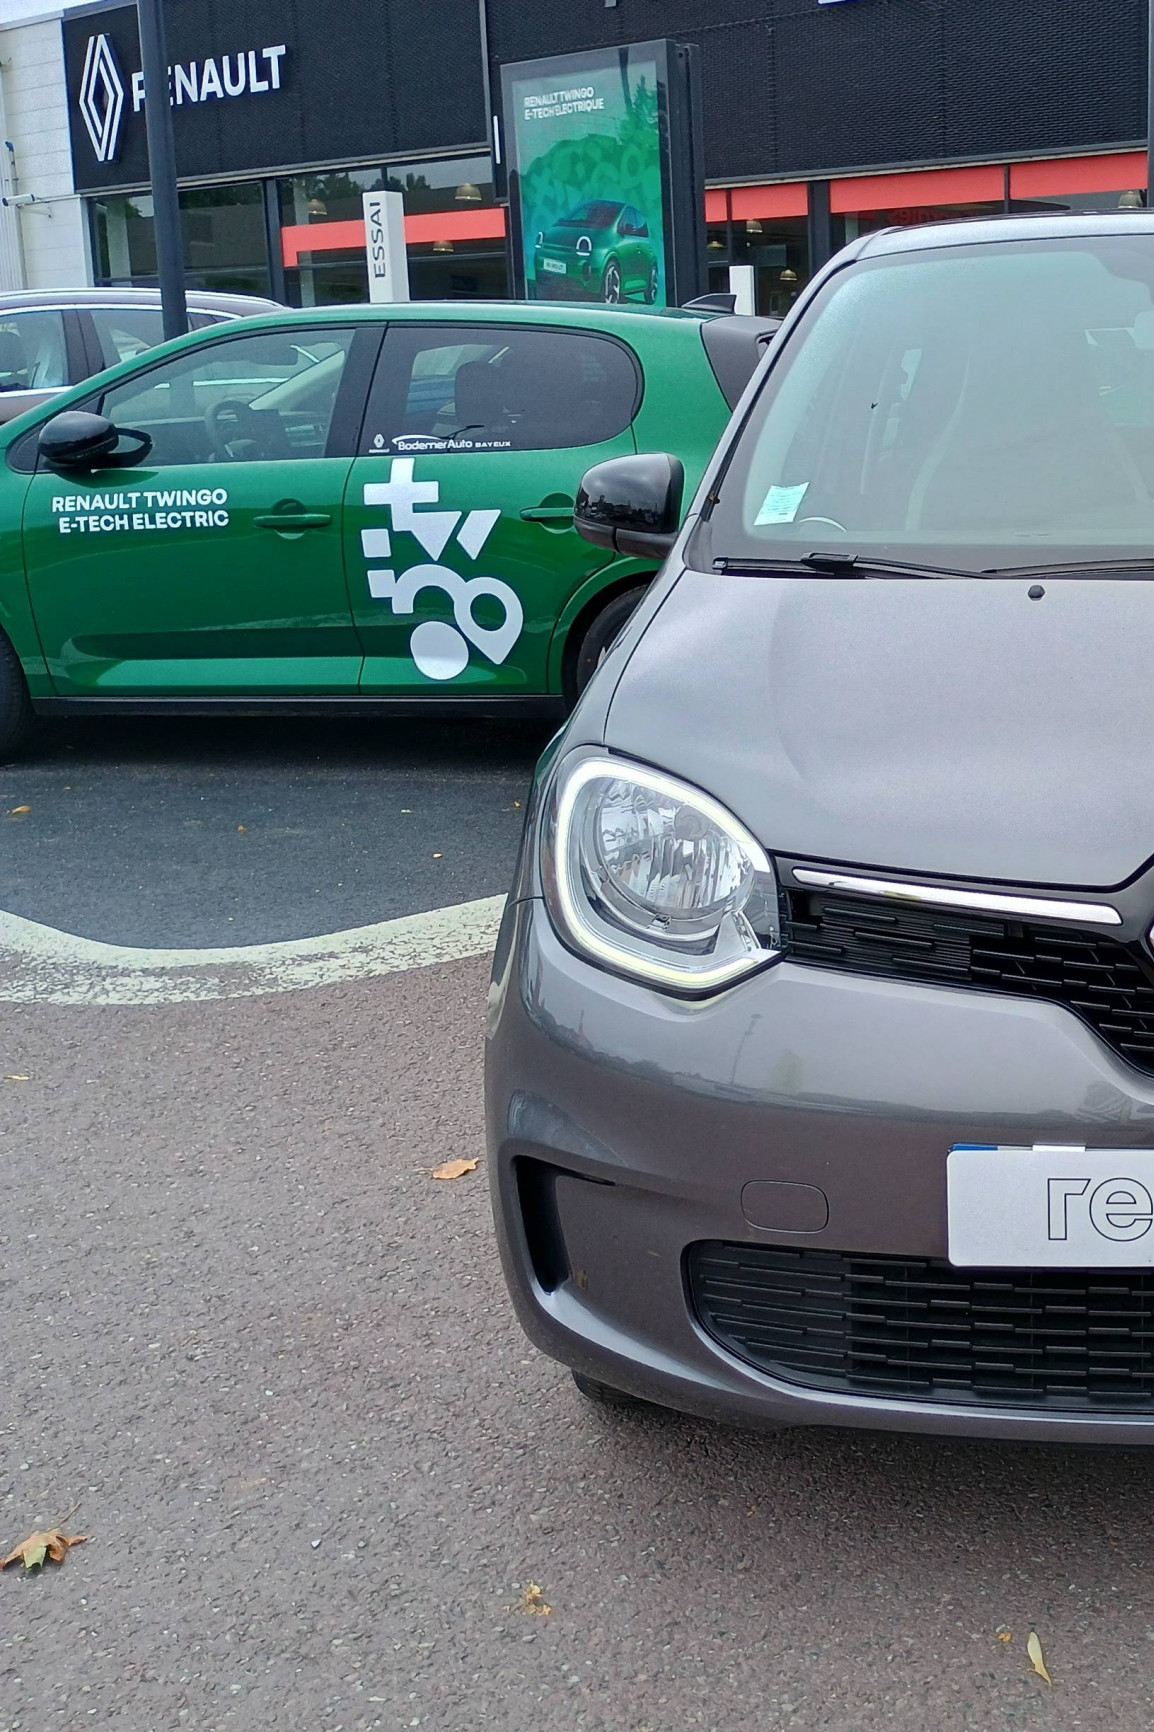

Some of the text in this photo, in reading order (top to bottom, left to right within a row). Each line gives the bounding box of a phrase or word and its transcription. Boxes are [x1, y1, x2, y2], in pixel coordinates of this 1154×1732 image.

[131, 45, 286, 112] RNAULT
[523, 87, 595, 108] RENAULT TWINGO
[524, 106, 555, 121] E-TECH
[369, 202, 386, 278] ESSAI
[474, 440, 511, 448] BAYEUX
[52, 488, 228, 512] RENAULT TWINGO
[59, 510, 229, 533] E-TECH ELECTRIC
